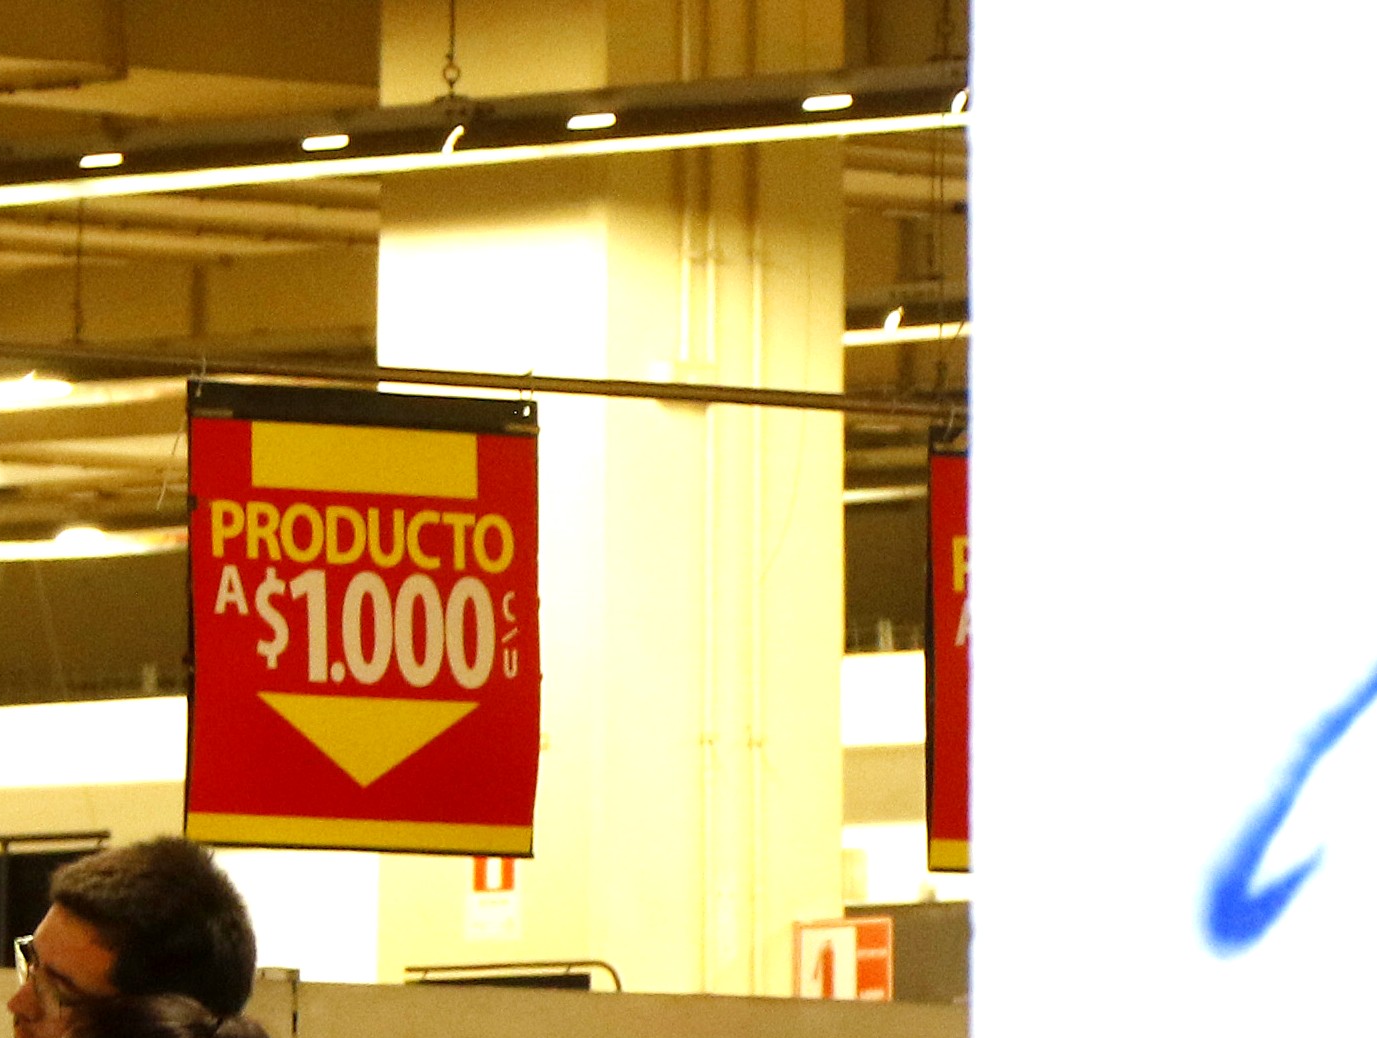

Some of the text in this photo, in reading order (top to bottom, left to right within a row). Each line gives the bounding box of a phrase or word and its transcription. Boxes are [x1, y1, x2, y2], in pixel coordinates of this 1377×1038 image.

[210, 498, 515, 575] PRODUCTO
[214, 563, 249, 616] A
[254, 566, 496, 691] $1.000
